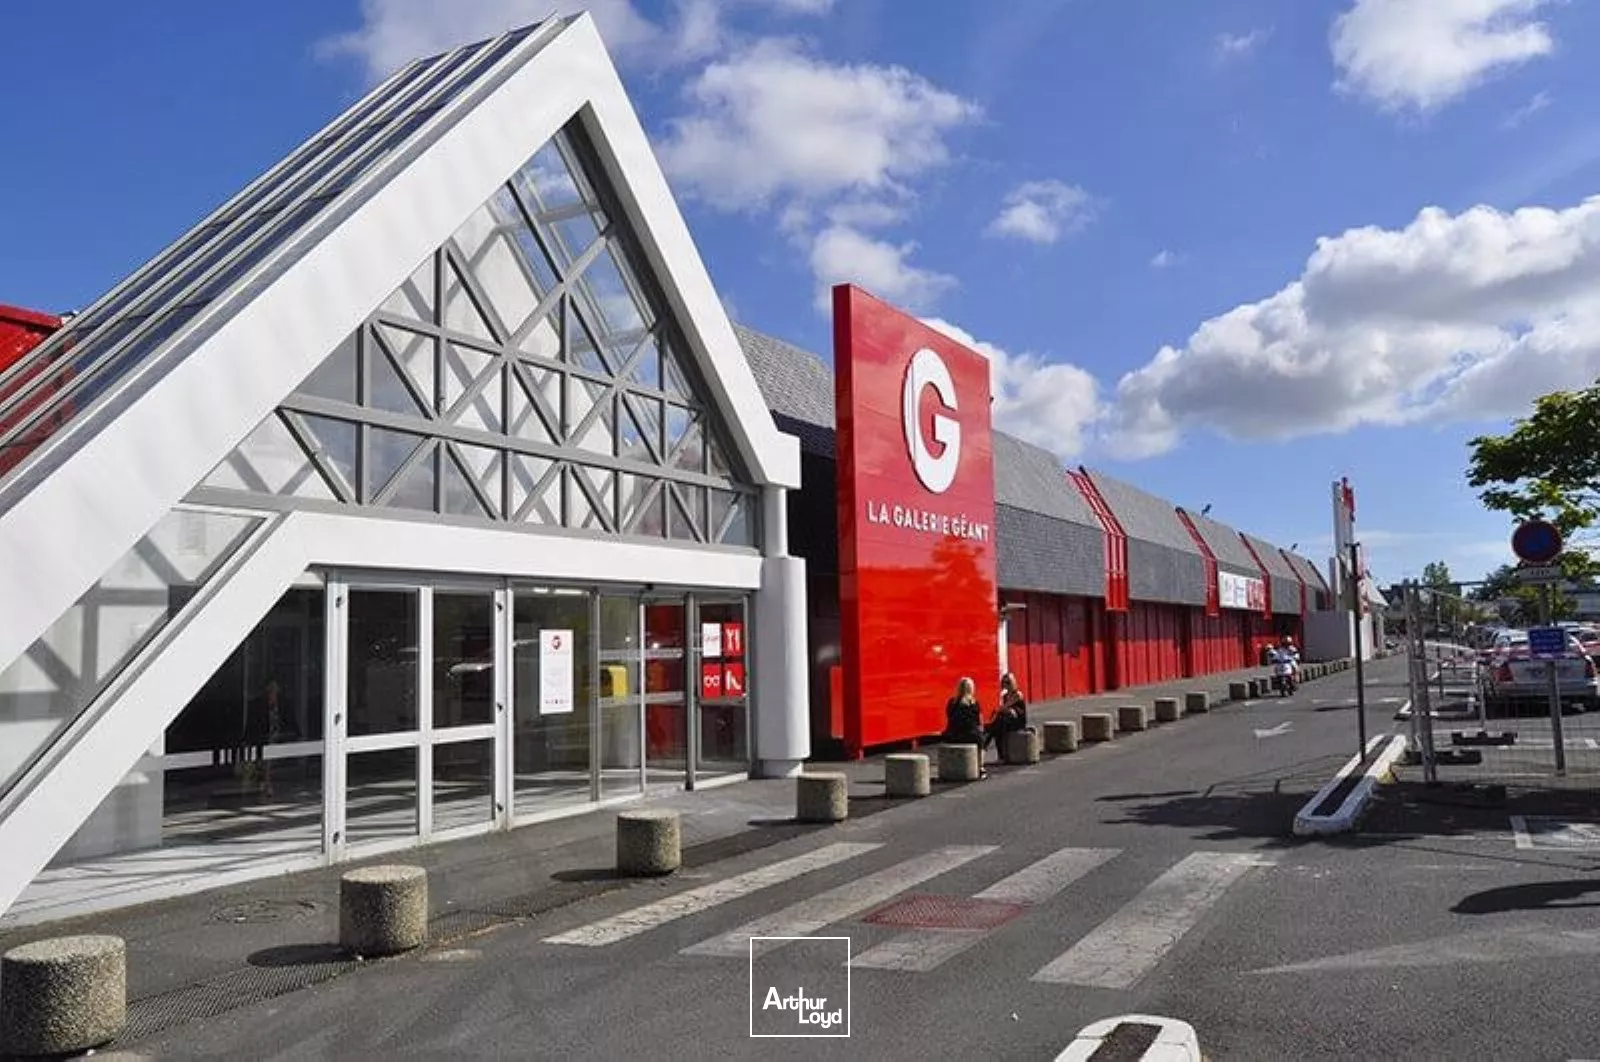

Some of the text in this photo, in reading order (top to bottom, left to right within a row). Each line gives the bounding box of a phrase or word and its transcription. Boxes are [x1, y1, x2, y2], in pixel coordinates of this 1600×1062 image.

[903, 348, 961, 492] G
[868, 501, 890, 524] LA
[951, 512, 989, 542] GÉANT
